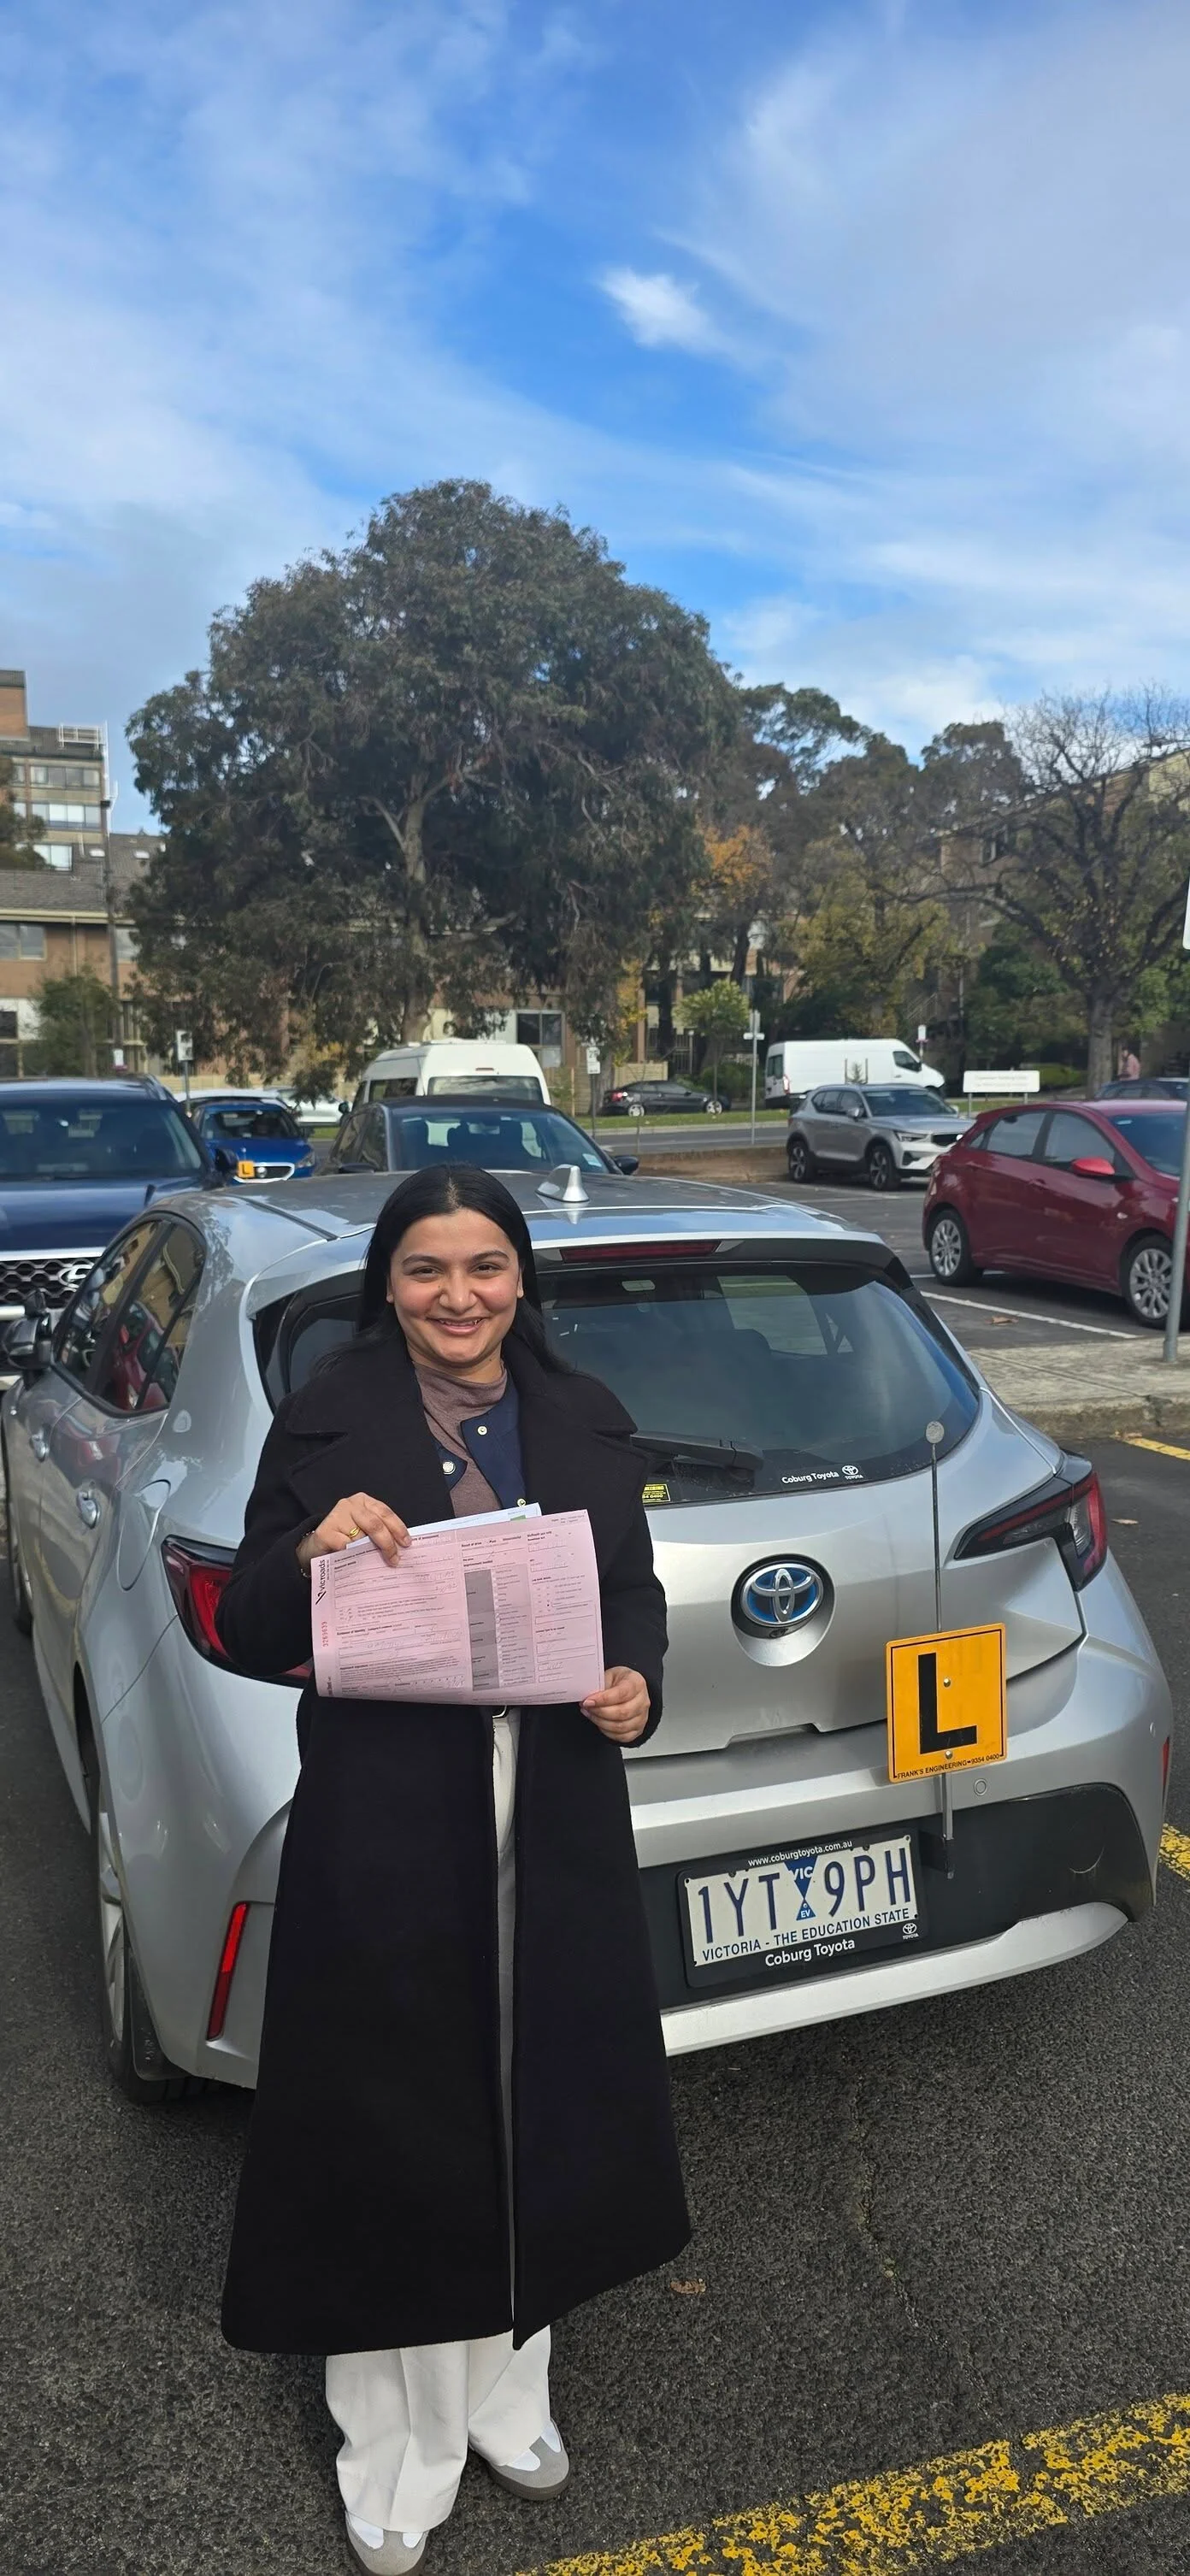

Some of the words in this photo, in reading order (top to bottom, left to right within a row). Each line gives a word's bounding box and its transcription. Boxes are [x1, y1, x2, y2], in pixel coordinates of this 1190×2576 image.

[241, 1164, 250, 1175] L
[781, 1475, 812, 1484] Coburg
[811, 1471, 839, 1480] Toyota
[918, 1652, 978, 1754] L
[897, 1768, 924, 1778] FRANK'S
[925, 1760, 968, 1774] ENGINEERING
[748, 1840, 853, 1867] www.coburgtoyota.com.au
[790, 1866, 813, 1881] VIC
[800, 1909, 811, 1919] EV
[703, 1938, 762, 1961] VICTORIA
[774, 1931, 798, 1946] THE
[802, 1917, 871, 1941] EDUCATION
[875, 1907, 910, 1925] STATE
[765, 1945, 812, 1967] Coburg
[814, 1938, 856, 1956] Toyota
